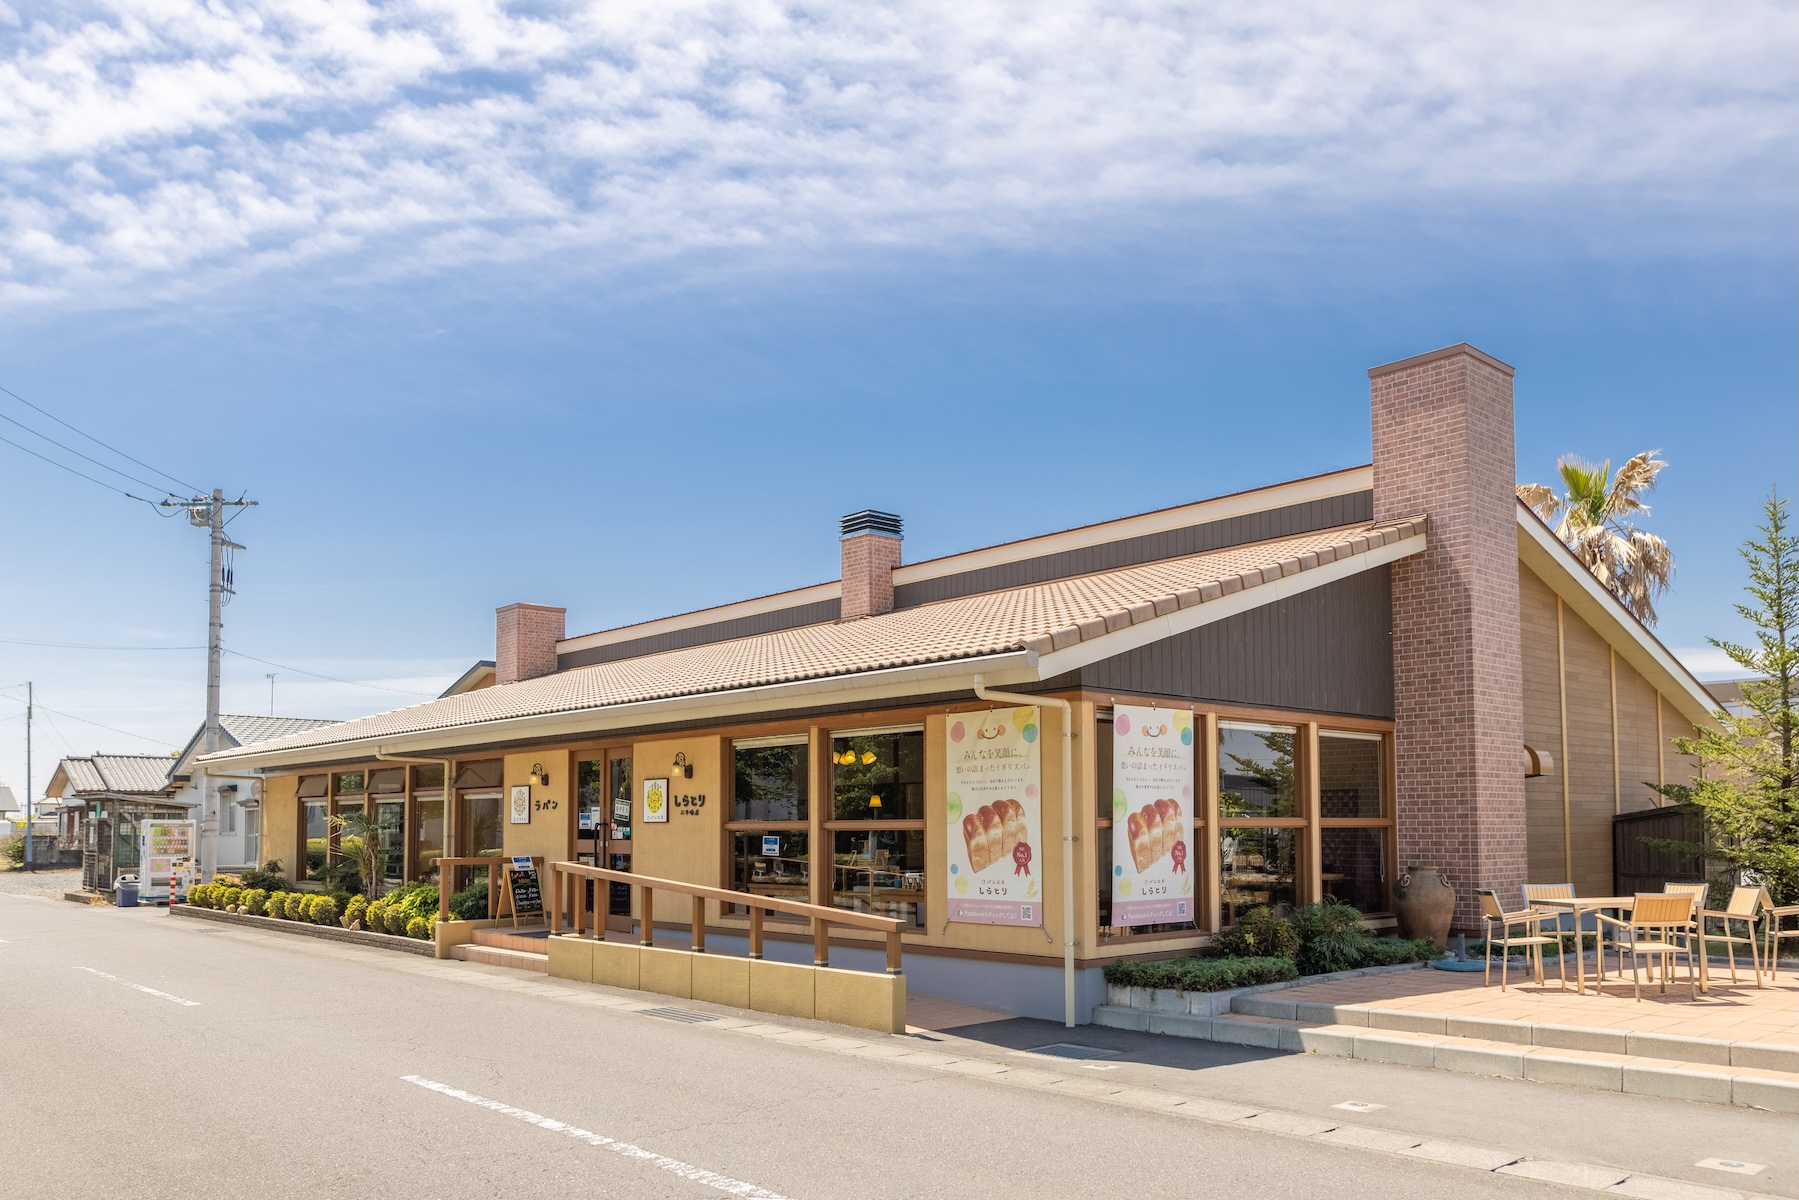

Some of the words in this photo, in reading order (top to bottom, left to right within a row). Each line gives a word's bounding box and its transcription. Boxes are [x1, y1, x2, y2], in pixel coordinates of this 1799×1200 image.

[964, 747, 1023, 760] みんなを笑顔に。
[1128, 746, 1181, 759] みんなを笑顔に。
[956, 762, 1031, 774] 想いの詰まったイギリスパン
[1120, 761, 1187, 771] 想いの詰まったイギリスパン
[534, 799, 558, 811] ラパン
[674, 794, 706, 808] しらとり
[979, 887, 1008, 896] しらとり
[1141, 886, 1167, 896] しらとり
